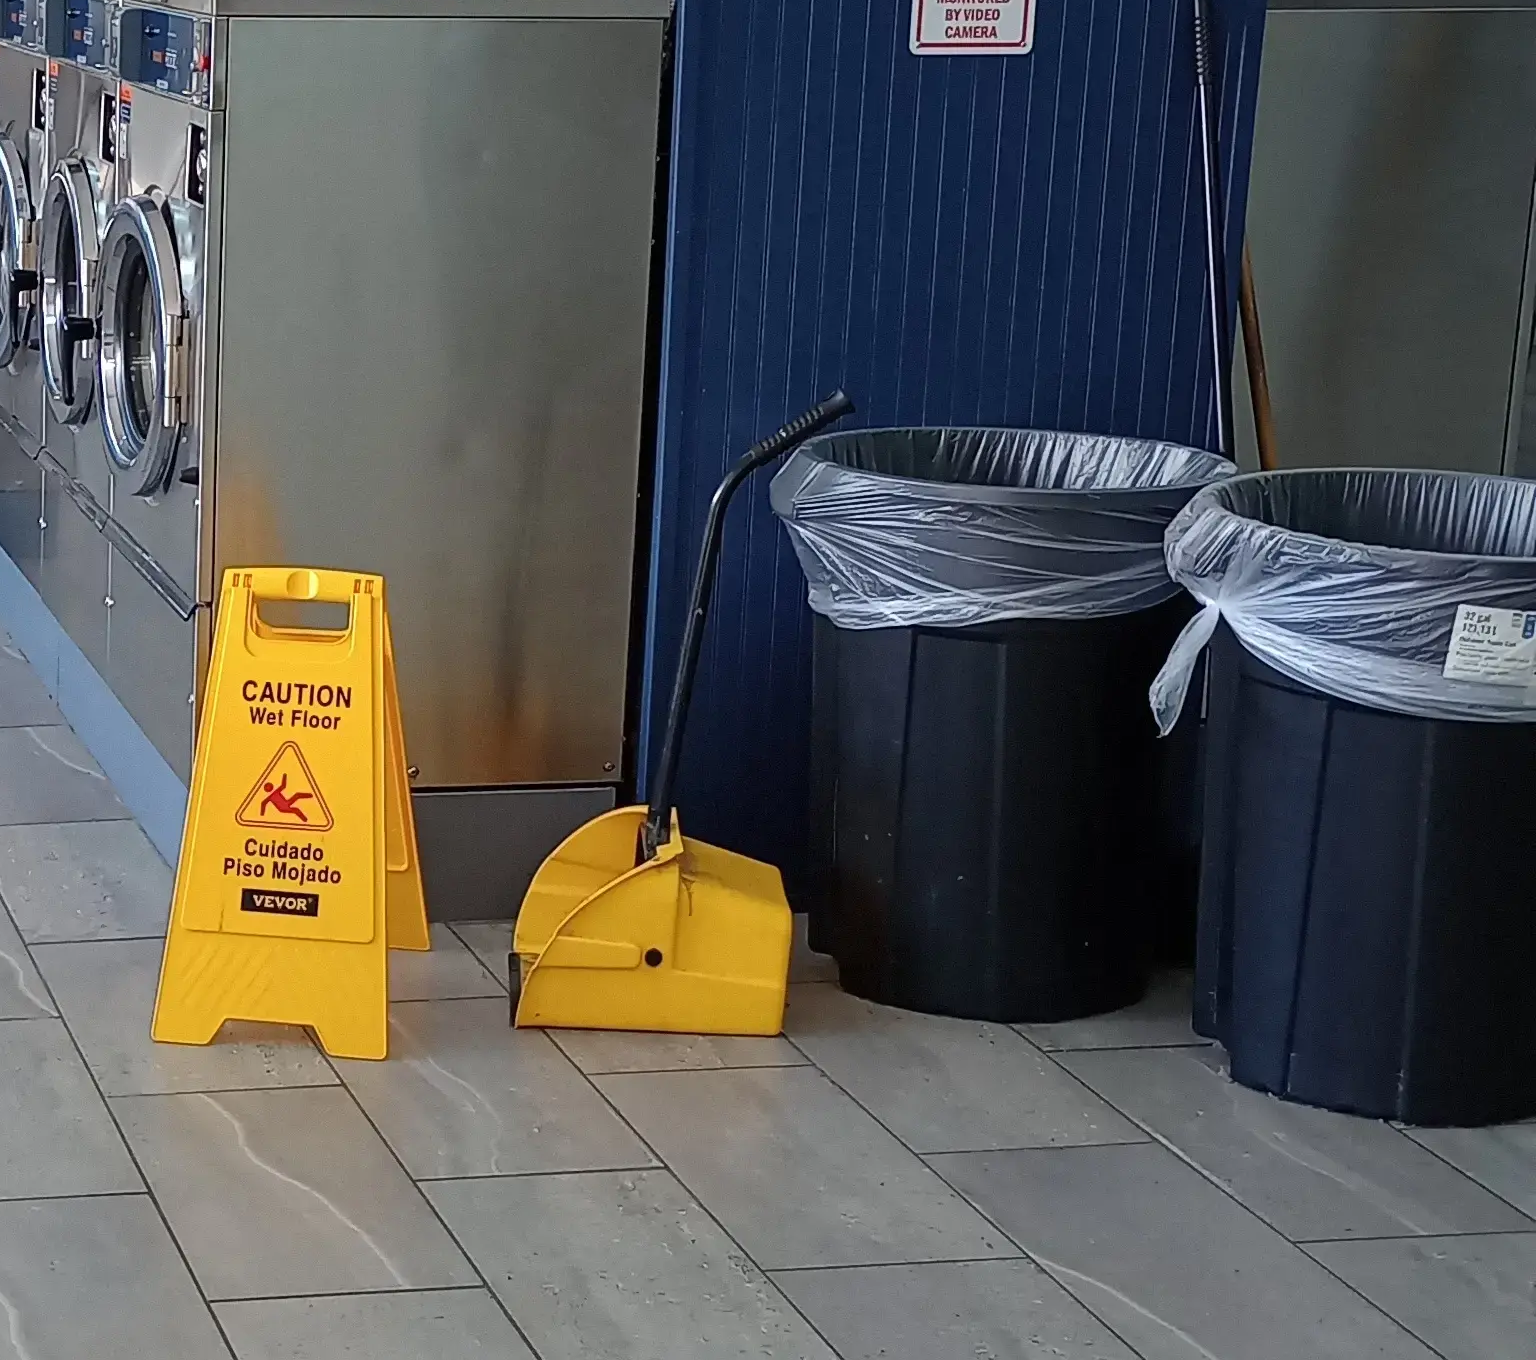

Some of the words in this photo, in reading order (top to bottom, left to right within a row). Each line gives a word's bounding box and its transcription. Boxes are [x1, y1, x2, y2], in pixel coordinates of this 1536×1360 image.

[945, 8, 961, 21] BY
[963, 8, 1001, 21] VIDEO
[944, 26, 998, 39] CAMERA
[242, 680, 352, 708] CAUTION
[249, 706, 284, 726] Wet
[291, 709, 342, 730] Floor
[244, 838, 324, 861] Cuidado
[223, 857, 265, 878] Piso
[271, 860, 342, 886] Mojado
[252, 894, 308, 911] VEVOR
